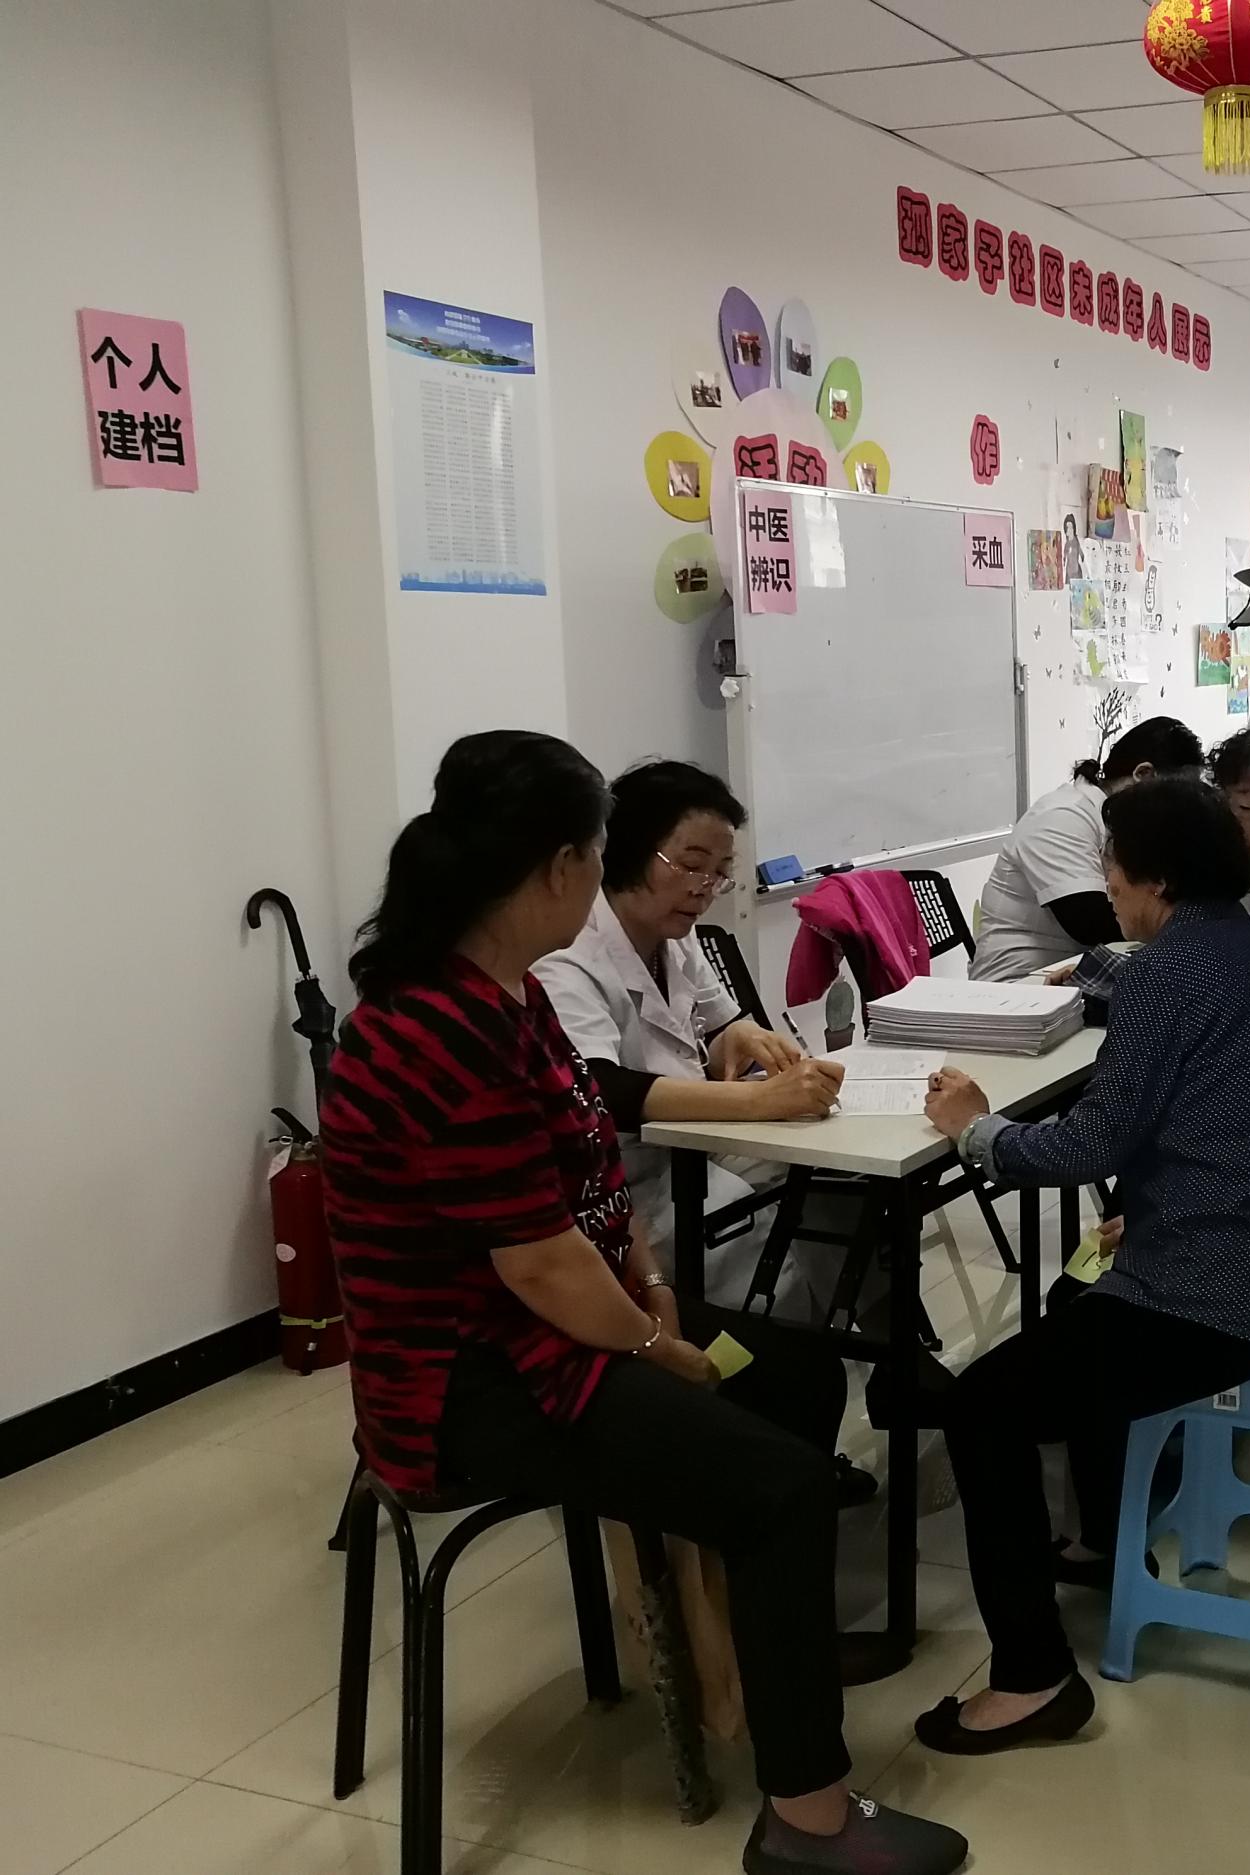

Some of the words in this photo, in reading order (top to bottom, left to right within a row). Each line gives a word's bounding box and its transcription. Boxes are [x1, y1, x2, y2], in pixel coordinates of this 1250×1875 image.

[91, 336, 182, 395] 个人
[97, 409, 185, 466] 建档
[748, 504, 790, 543] 中医
[972, 536, 1004, 569] 采血
